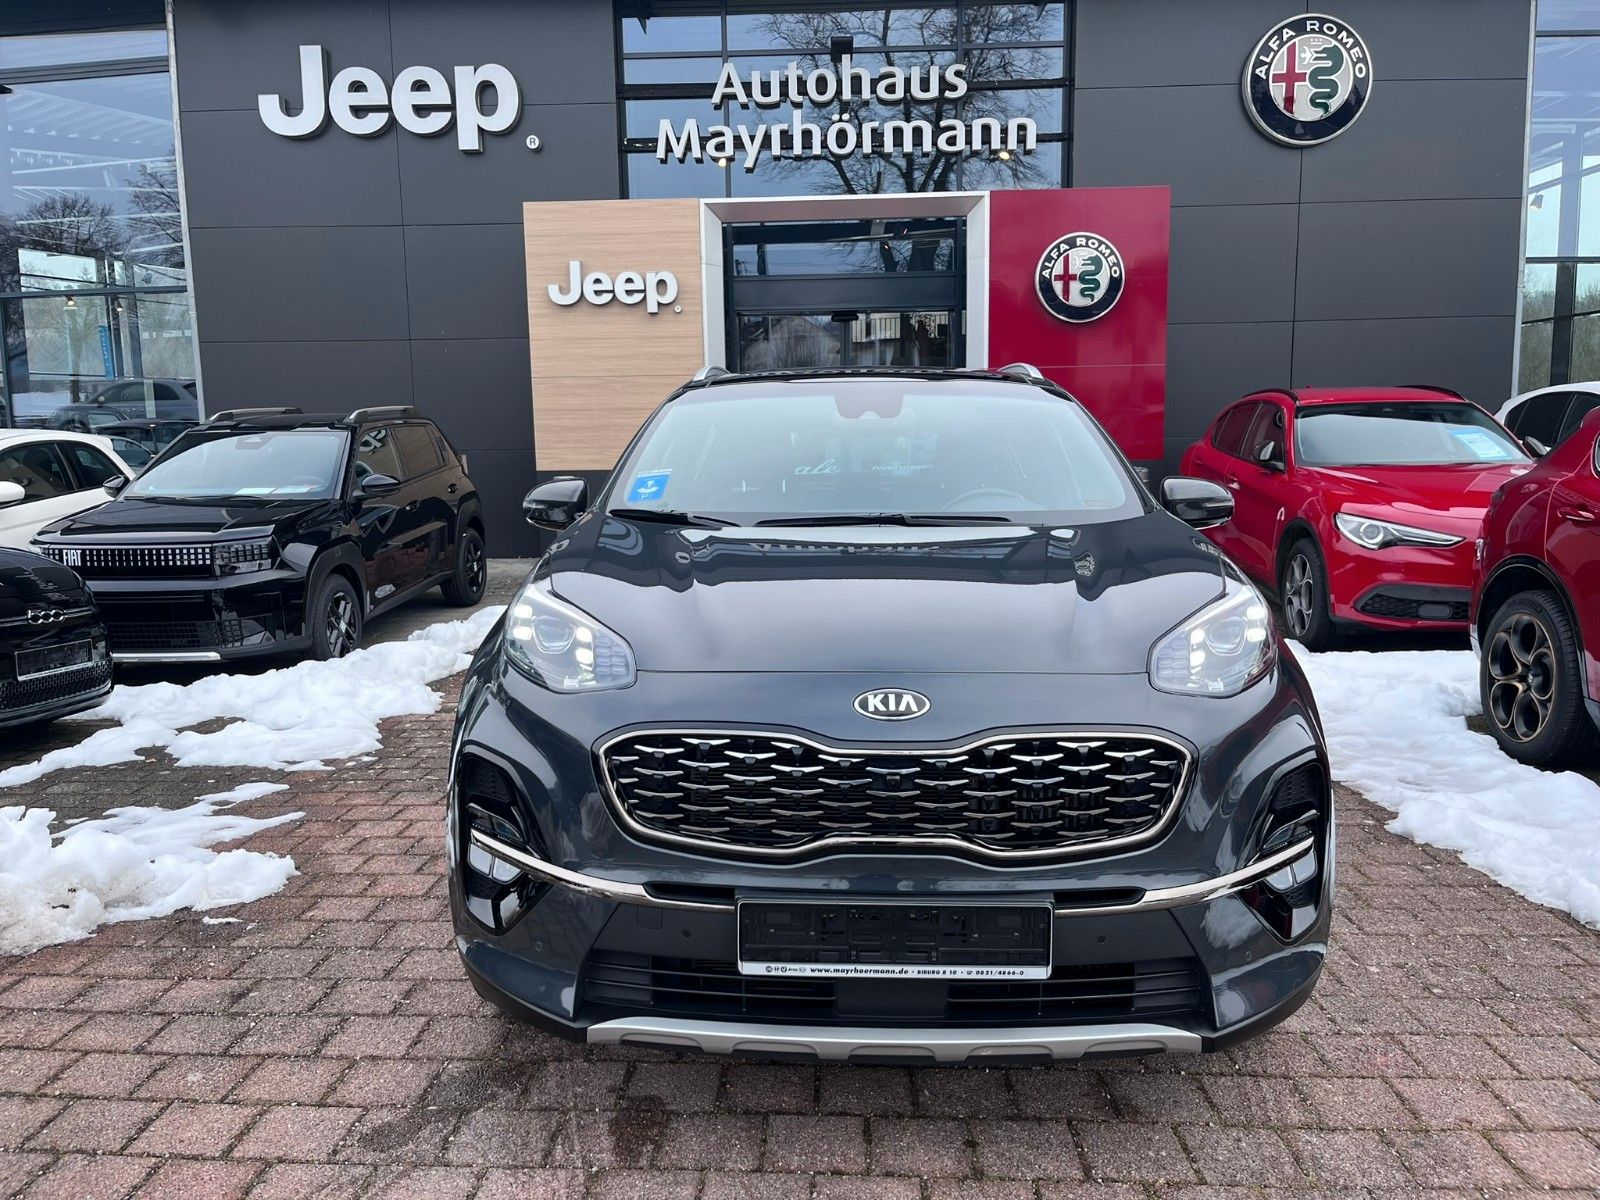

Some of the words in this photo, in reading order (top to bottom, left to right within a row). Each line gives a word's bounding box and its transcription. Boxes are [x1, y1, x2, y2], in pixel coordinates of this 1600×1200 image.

[1255, 27, 1296, 80] ALFA
[1305, 20, 1367, 79] ROMEO
[257, 44, 521, 152] Jeep
[710, 53, 968, 107] Autohaus
[655, 109, 1038, 171] Mayrhörmann
[1041, 242, 1070, 279] ALFA
[1075, 236, 1121, 278] ROMEO
[547, 260, 679, 314] Jeep
[62, 549, 82, 567] FIAT
[866, 693, 919, 712] KIA
[809, 966, 909, 976] www.mayrhoermann.de
